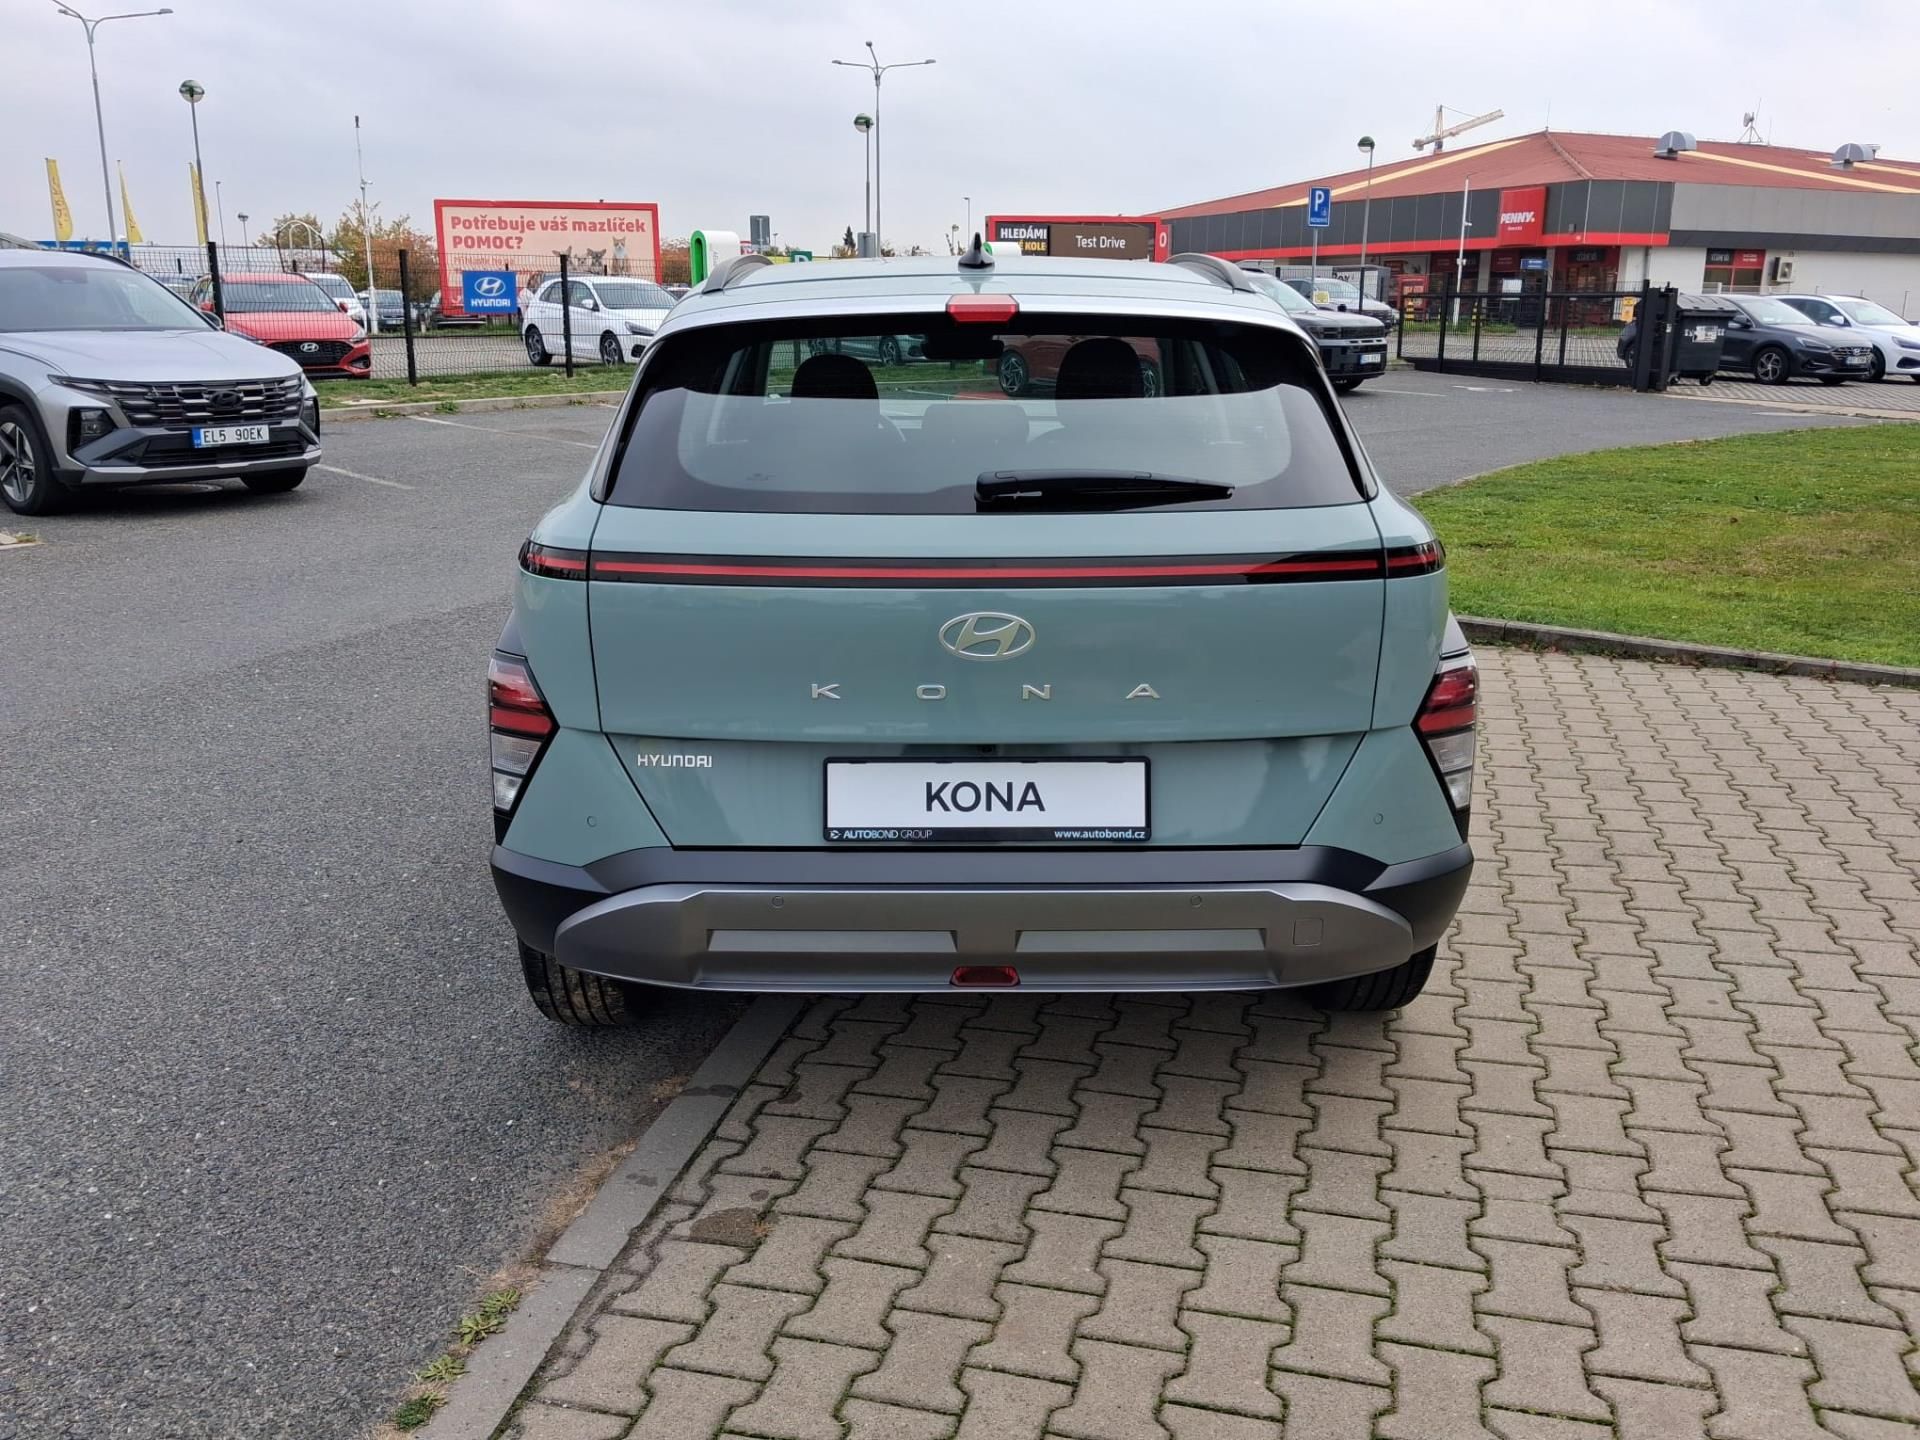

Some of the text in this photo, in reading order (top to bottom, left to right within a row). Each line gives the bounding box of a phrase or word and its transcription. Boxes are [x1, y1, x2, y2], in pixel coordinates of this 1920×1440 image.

[1315, 190, 1325, 212] P
[451, 214, 646, 234] Potřebuje váš mazlíček
[452, 236, 523, 249] POMOC?
[1075, 235, 1126, 249] Test Drive
[471, 298, 511, 307] HYUNDAI
[203, 427, 263, 443] EL5 90EK
[637, 754, 713, 768] HYUNDAI
[926, 781, 1046, 812] KONA
[843, 828, 1146, 839] AUTOBOND GROUP www.autobond.cz
